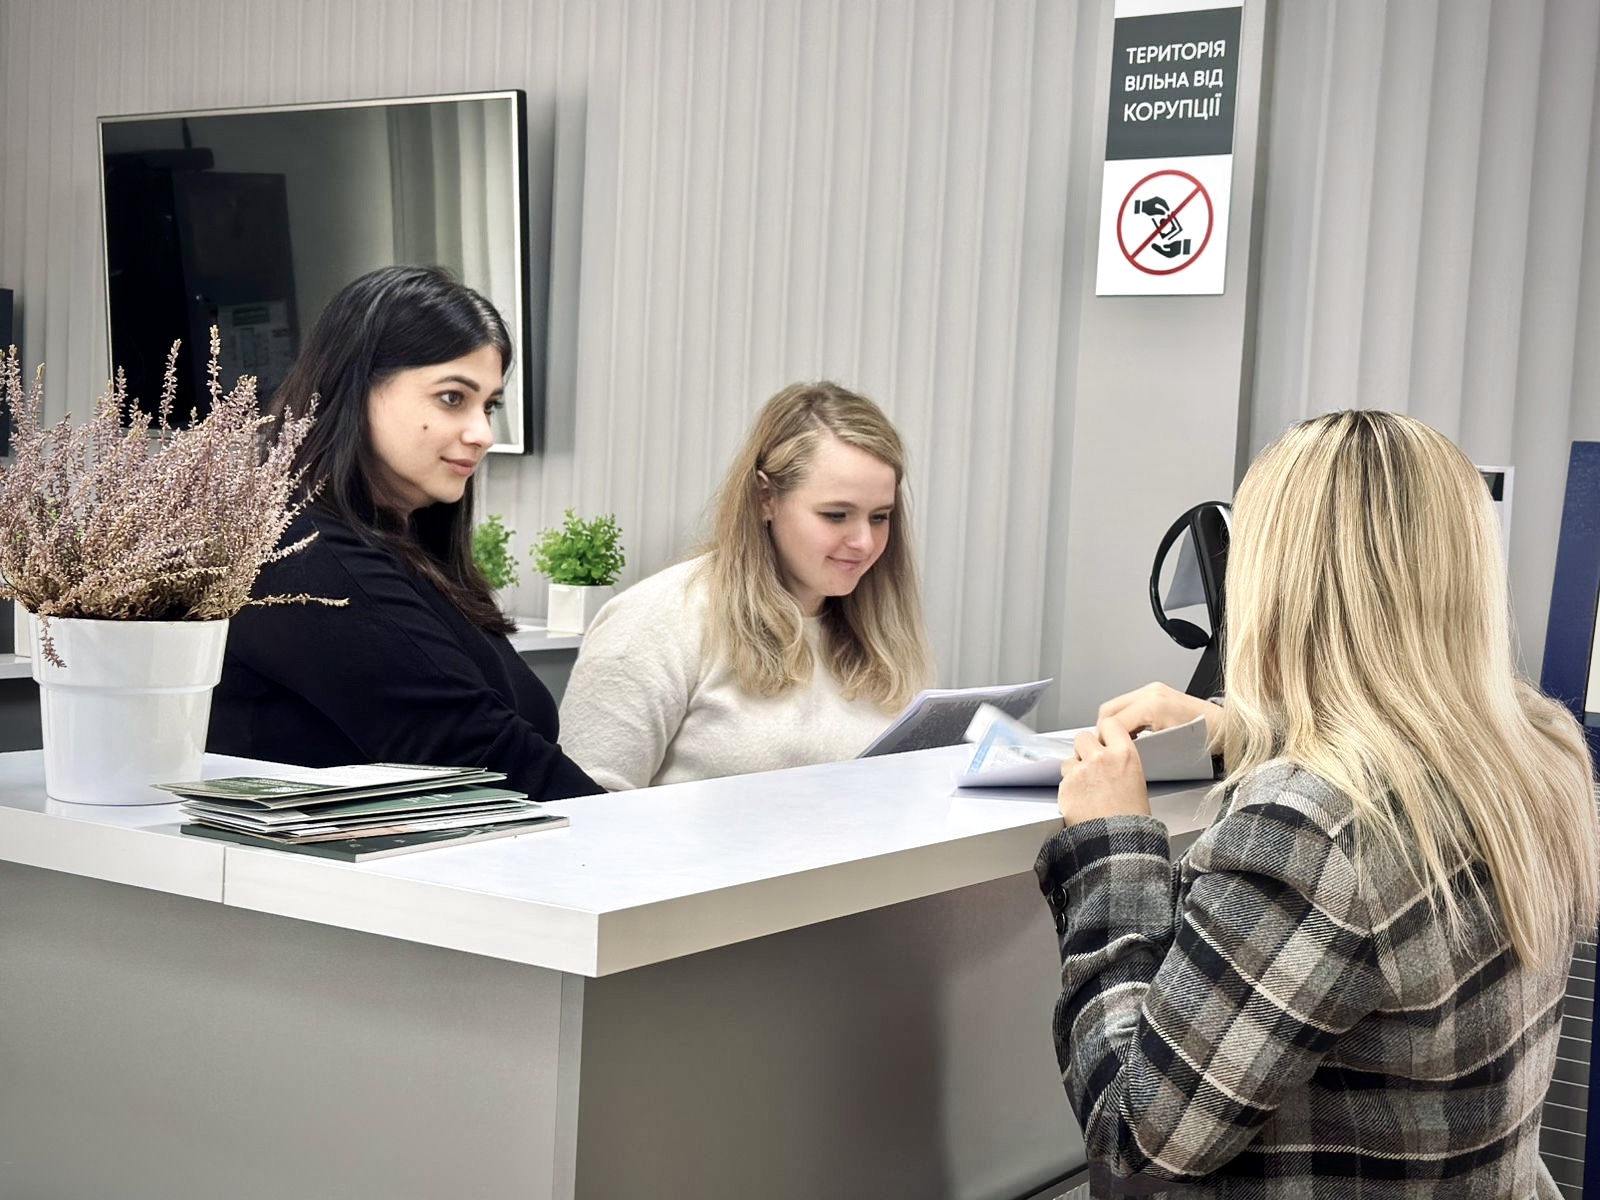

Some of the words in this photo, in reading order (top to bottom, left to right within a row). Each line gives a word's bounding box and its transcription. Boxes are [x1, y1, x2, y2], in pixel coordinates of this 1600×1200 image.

[1126, 40, 1226, 64] ТЕРИТОРІЯ
[1124, 71, 1189, 92] ВІЛЬНА
[1193, 68, 1223, 88] ВІД
[1123, 92, 1222, 122] КОРУПЦІЇ
